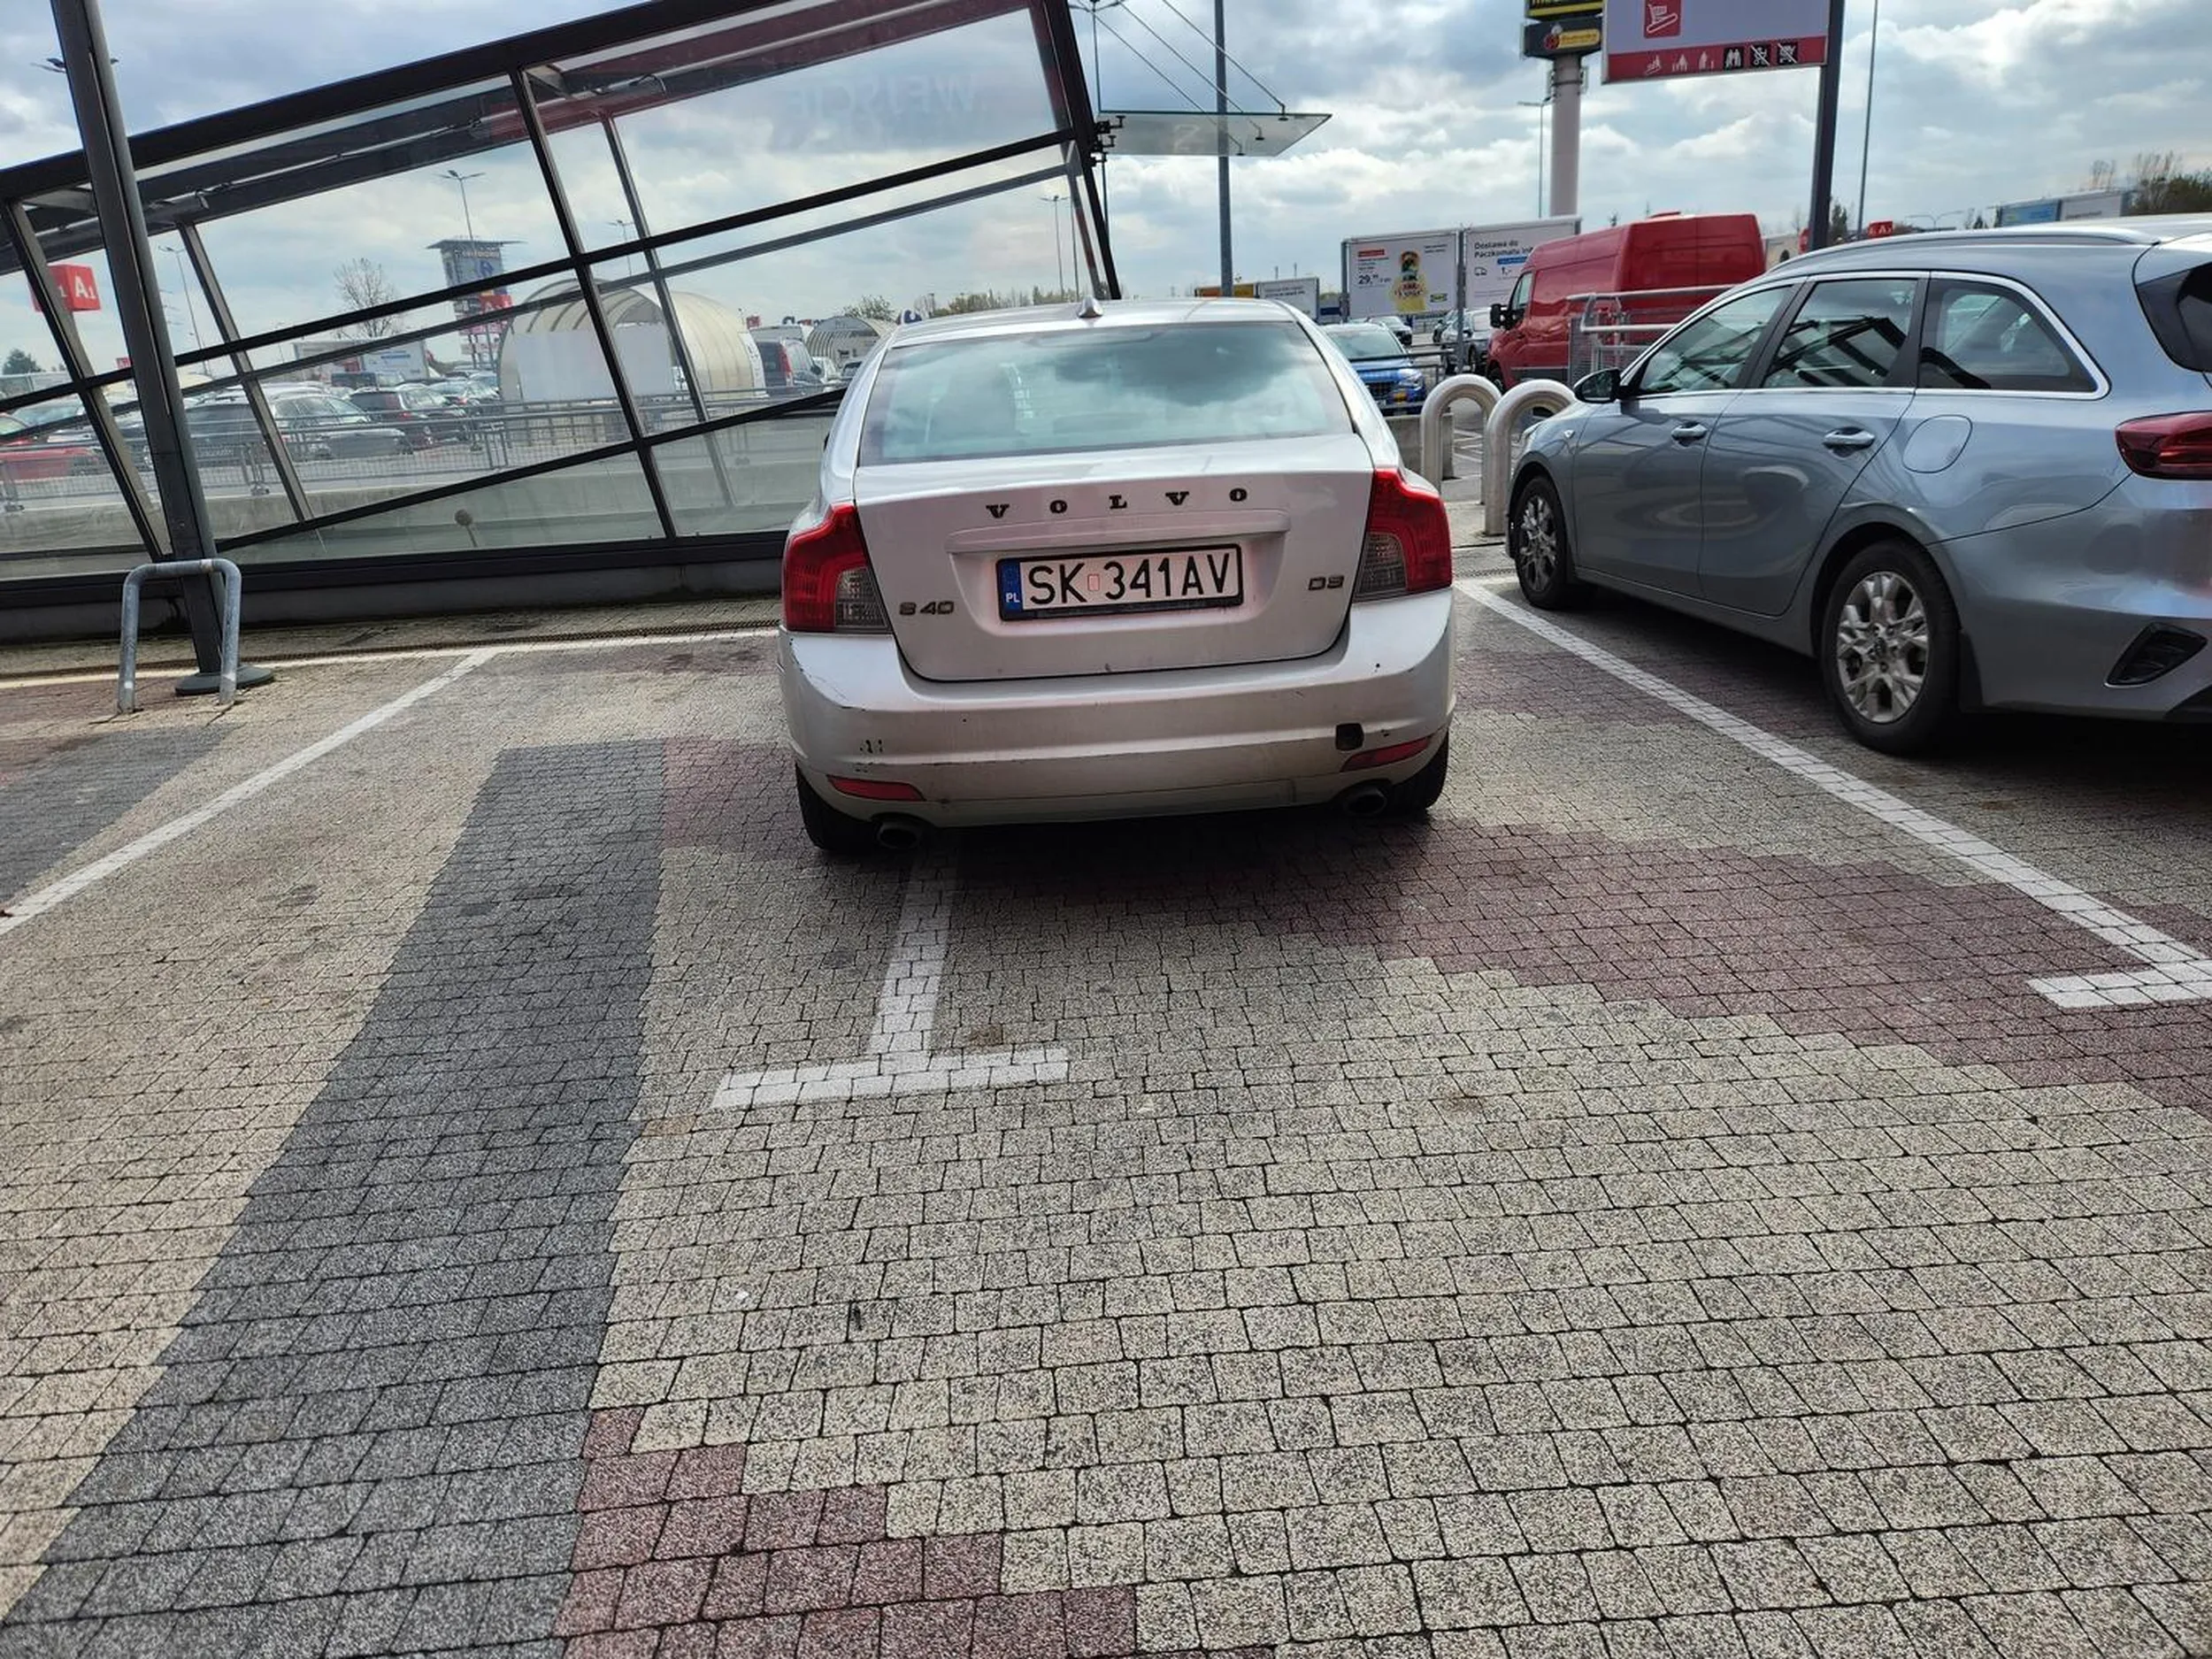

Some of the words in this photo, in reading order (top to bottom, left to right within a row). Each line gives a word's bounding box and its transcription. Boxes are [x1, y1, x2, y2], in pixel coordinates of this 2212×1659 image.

[74, 274, 96, 299] A1
[986, 488, 1248, 519] VOLVO
[1027, 561, 1088, 605] SK
[1102, 551, 1230, 601] 341AV
[1005, 592, 1020, 603] PL
